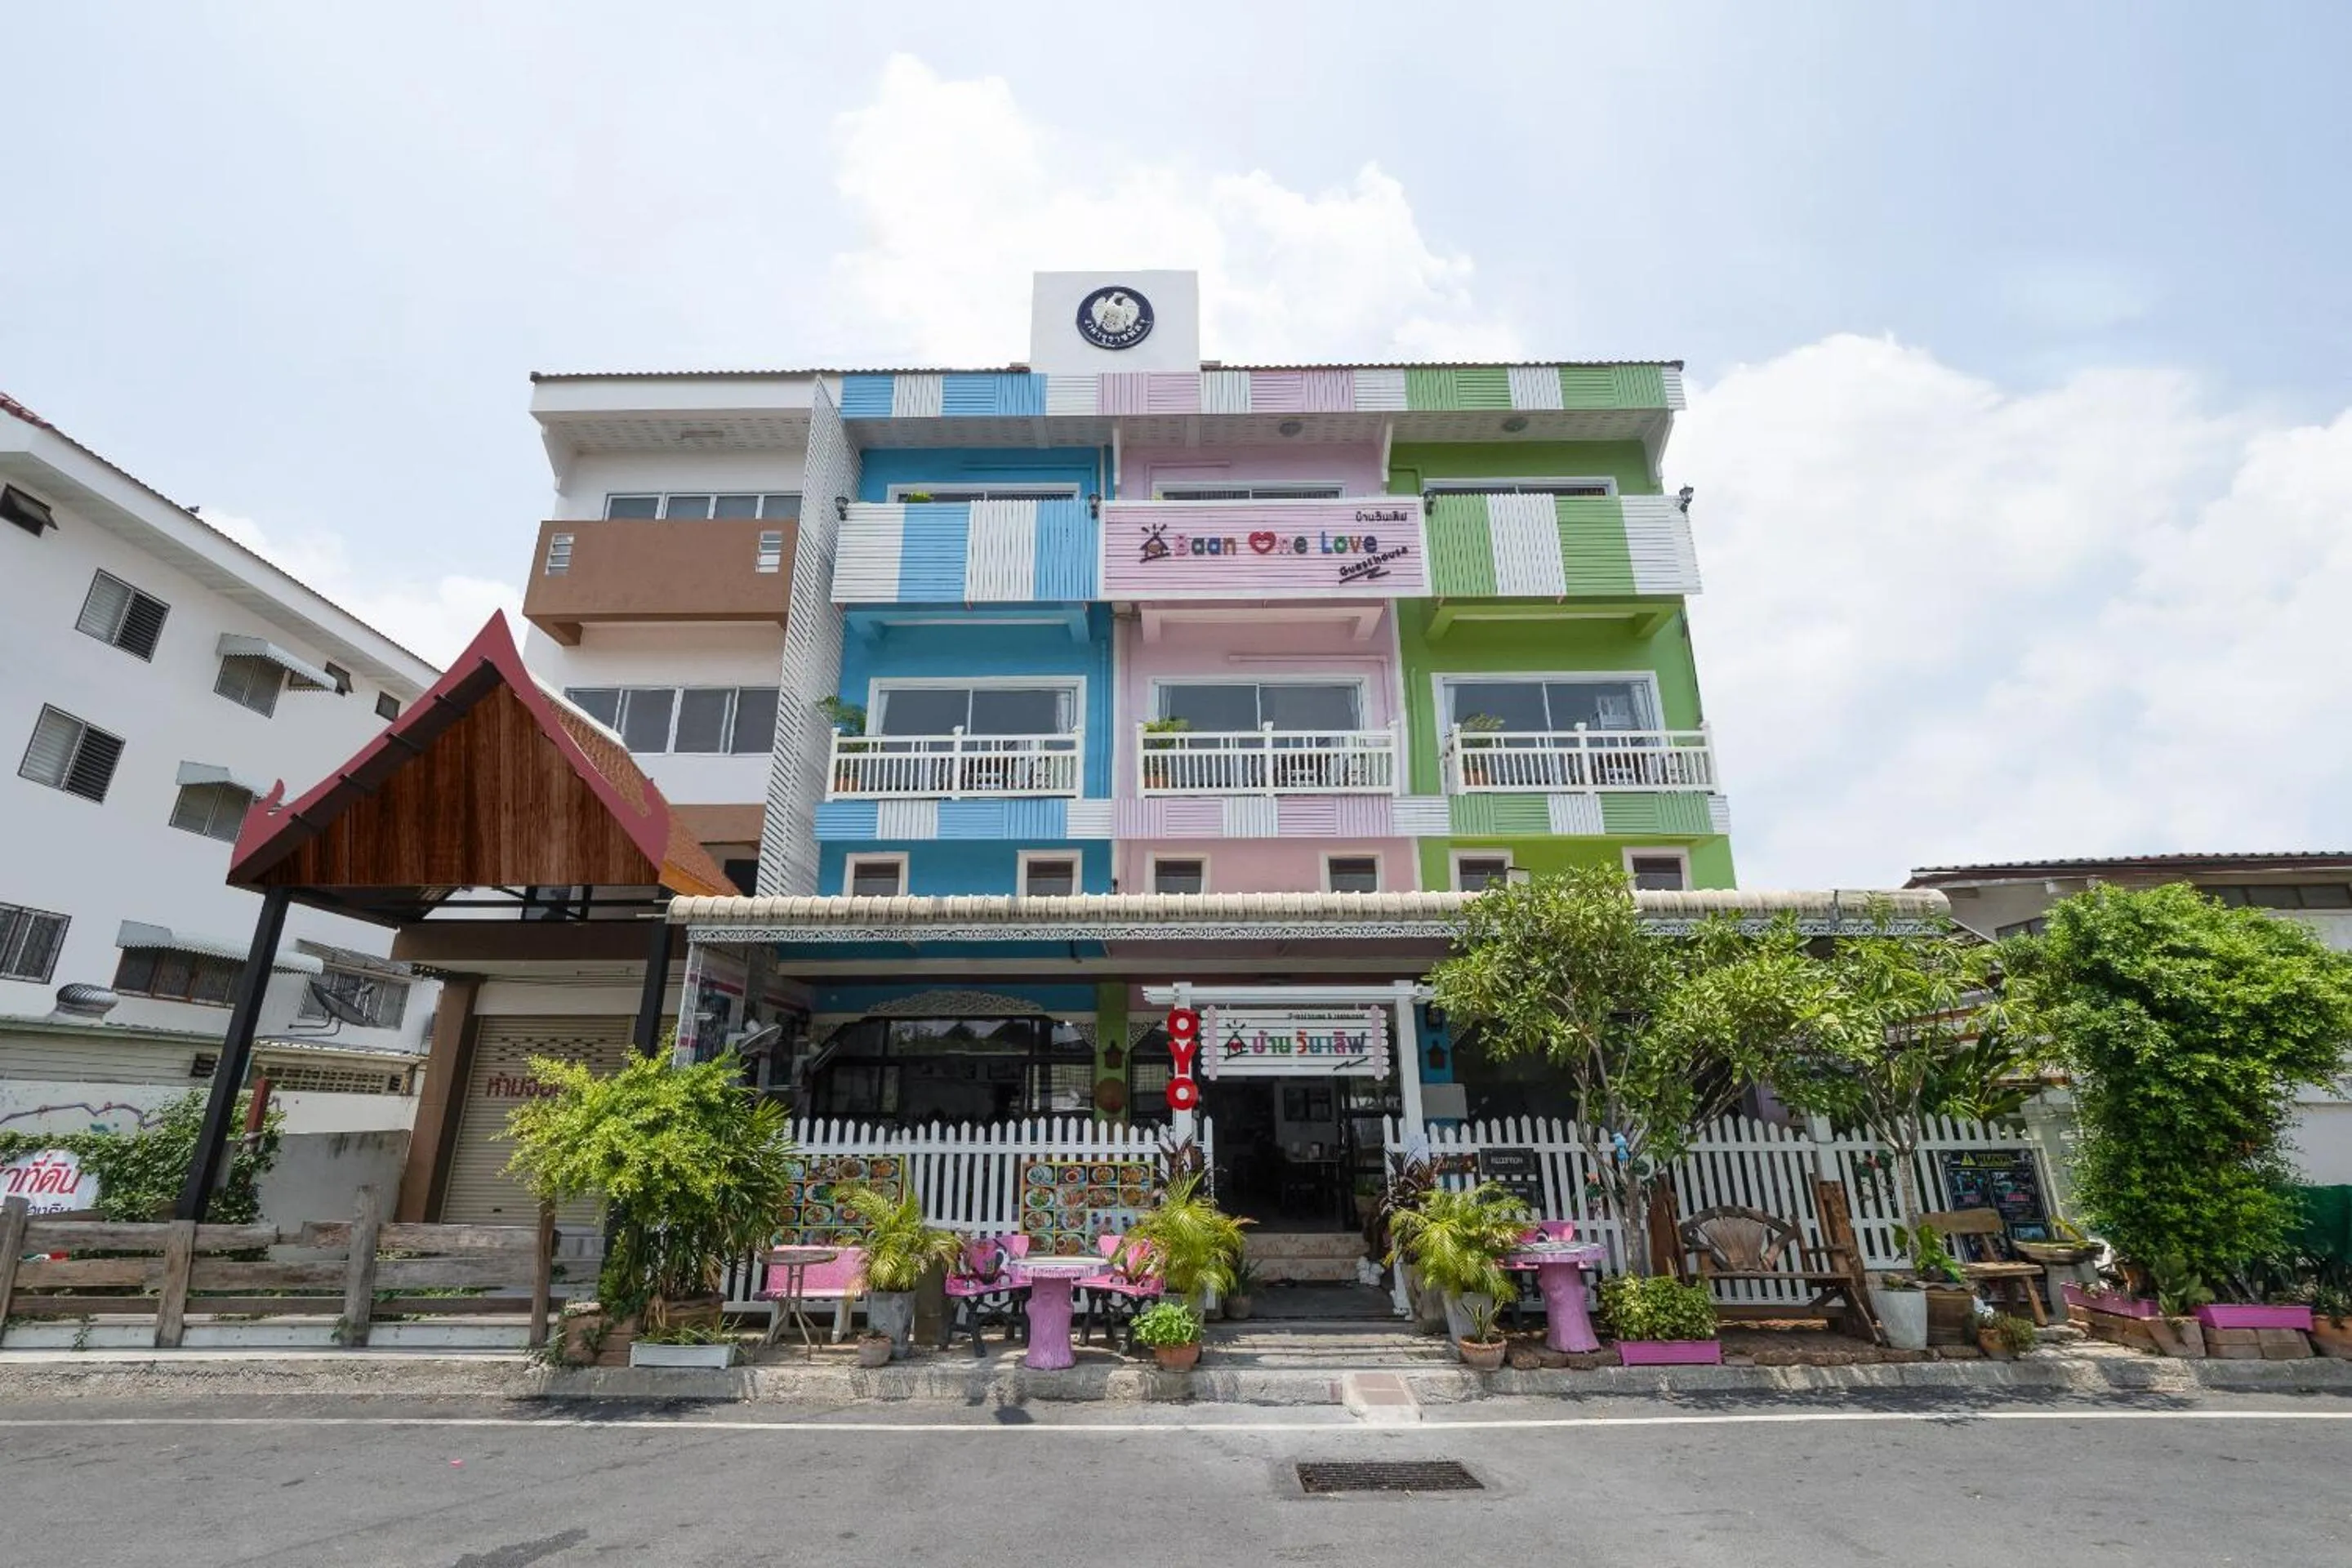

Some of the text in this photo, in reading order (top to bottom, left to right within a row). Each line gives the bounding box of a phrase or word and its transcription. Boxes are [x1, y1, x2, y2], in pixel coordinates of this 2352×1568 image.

[1174, 533, 1236, 556] Baan
[1321, 531, 1378, 554] Love
[1167, 1010, 1199, 1109] OYO
